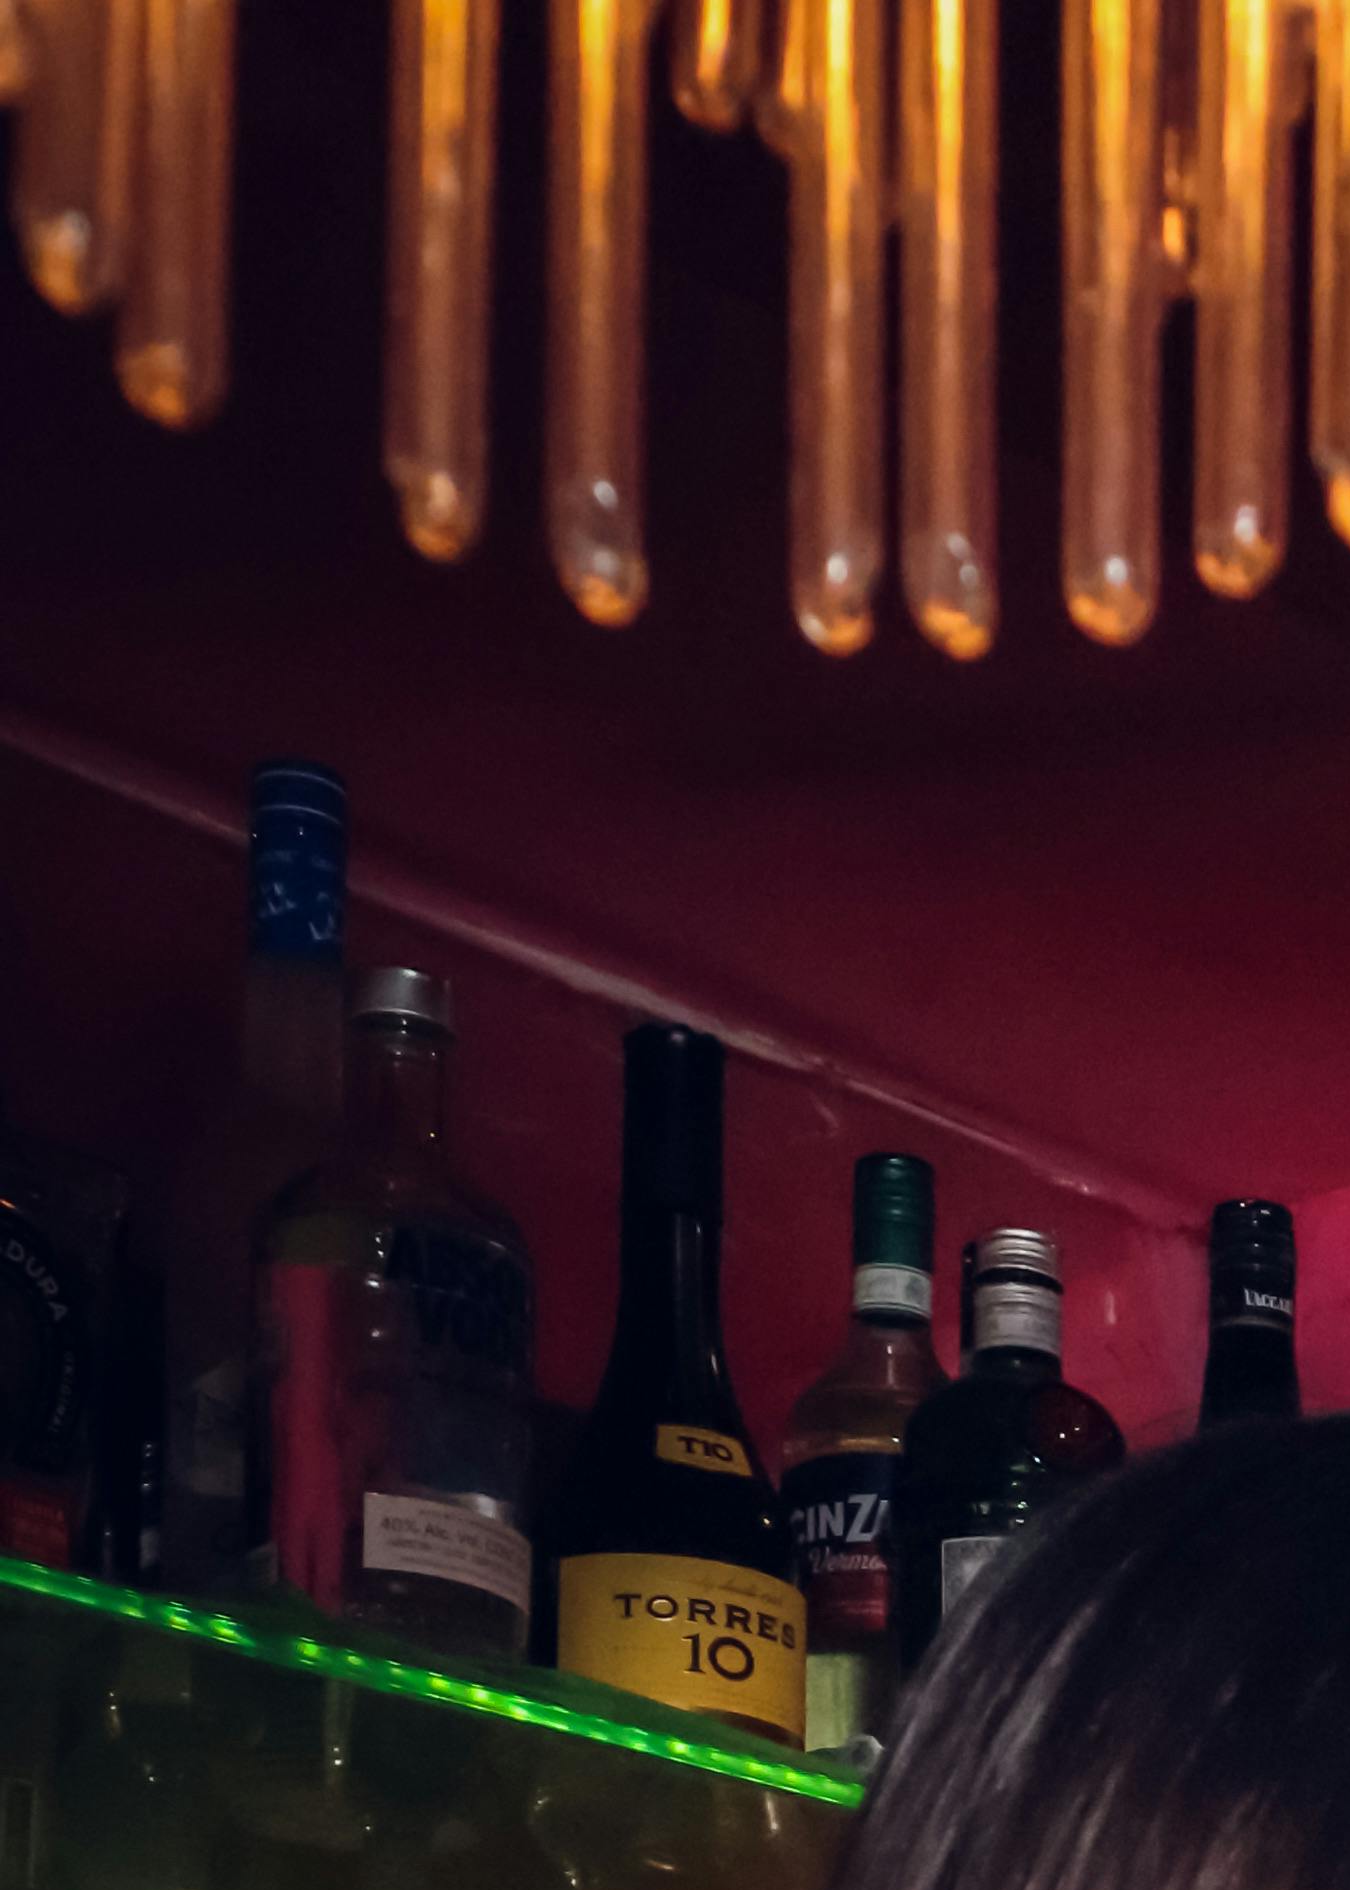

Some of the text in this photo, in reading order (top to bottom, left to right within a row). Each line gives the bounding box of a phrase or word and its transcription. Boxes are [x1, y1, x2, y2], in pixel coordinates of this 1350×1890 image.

[677, 1436, 733, 1461] T10
[614, 1593, 796, 1649] TORRES
[682, 1634, 755, 1681] 10
